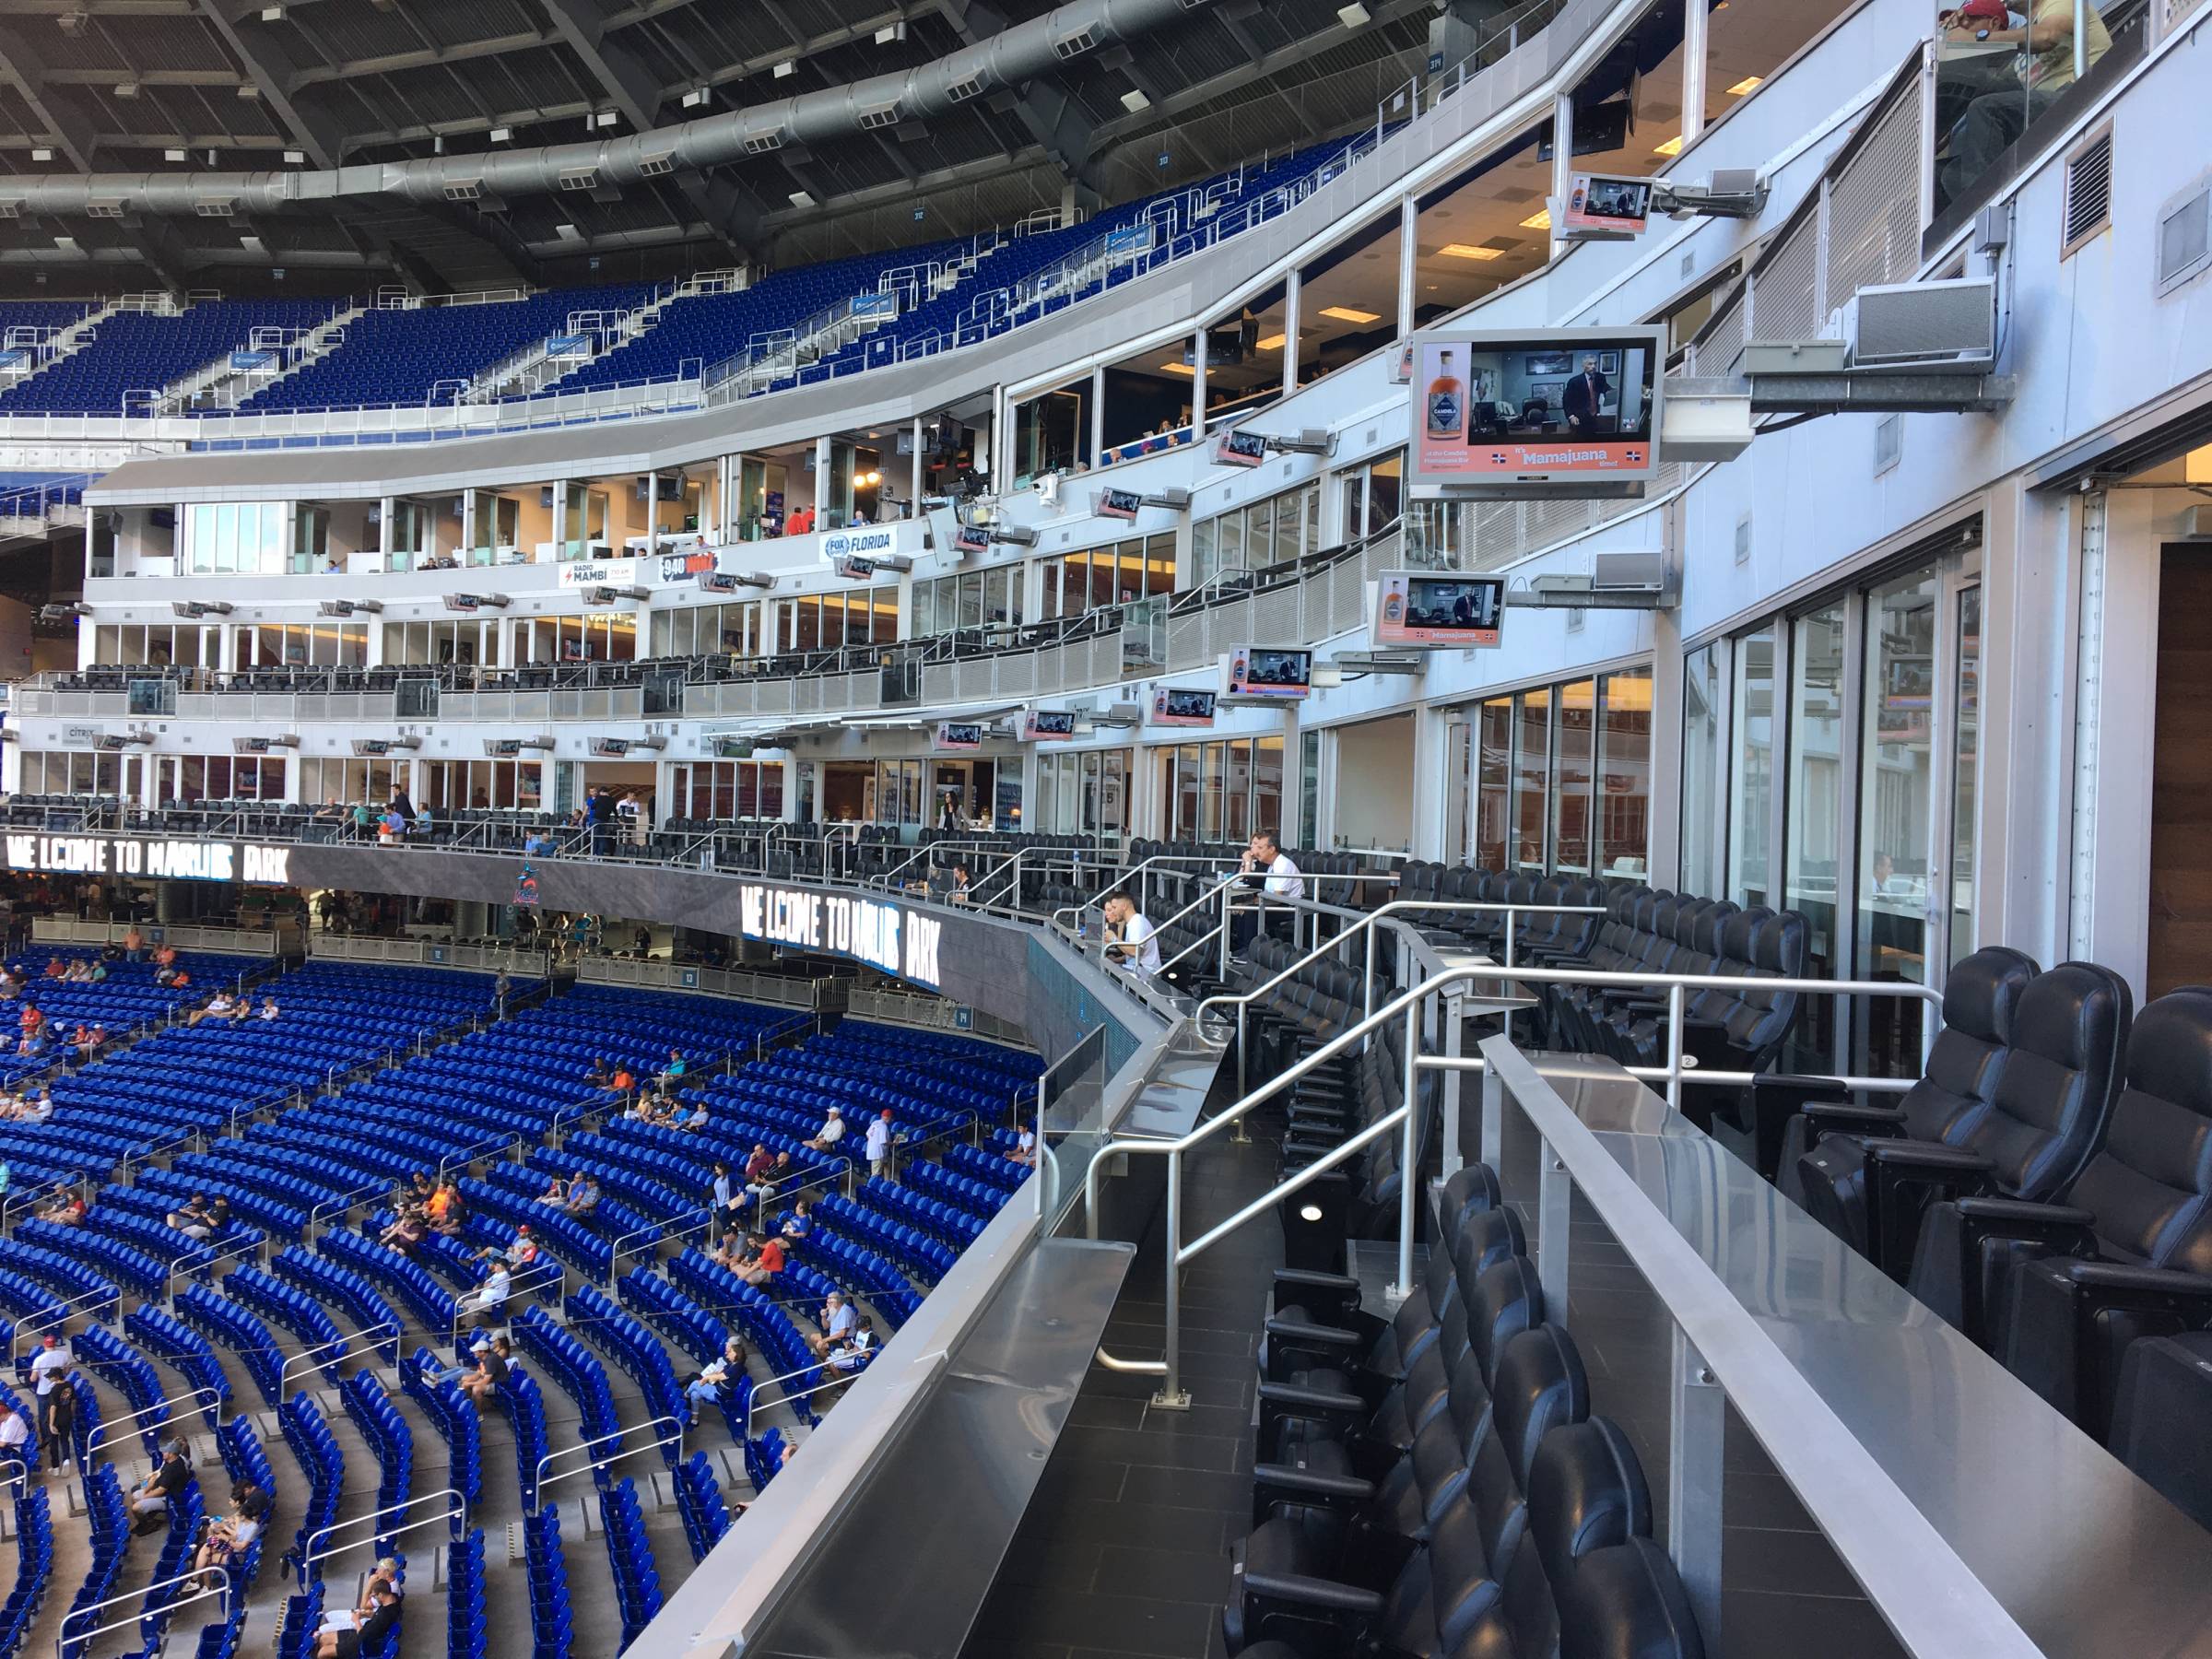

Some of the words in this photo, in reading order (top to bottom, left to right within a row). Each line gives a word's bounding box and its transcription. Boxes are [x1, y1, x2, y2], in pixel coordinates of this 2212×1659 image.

[1523, 449, 1607, 465] Mamajuana
[830, 539, 844, 550] FOX
[851, 534, 890, 552] FLORIDA
[574, 564, 594, 572] RADIO
[574, 568, 607, 582] MAMBÍ
[665, 558, 685, 576] 940
[114, 841, 141, 874] TO
[243, 845, 289, 883] PARK
[827, 898, 849, 950] TO
[906, 911, 940, 986] PARK
